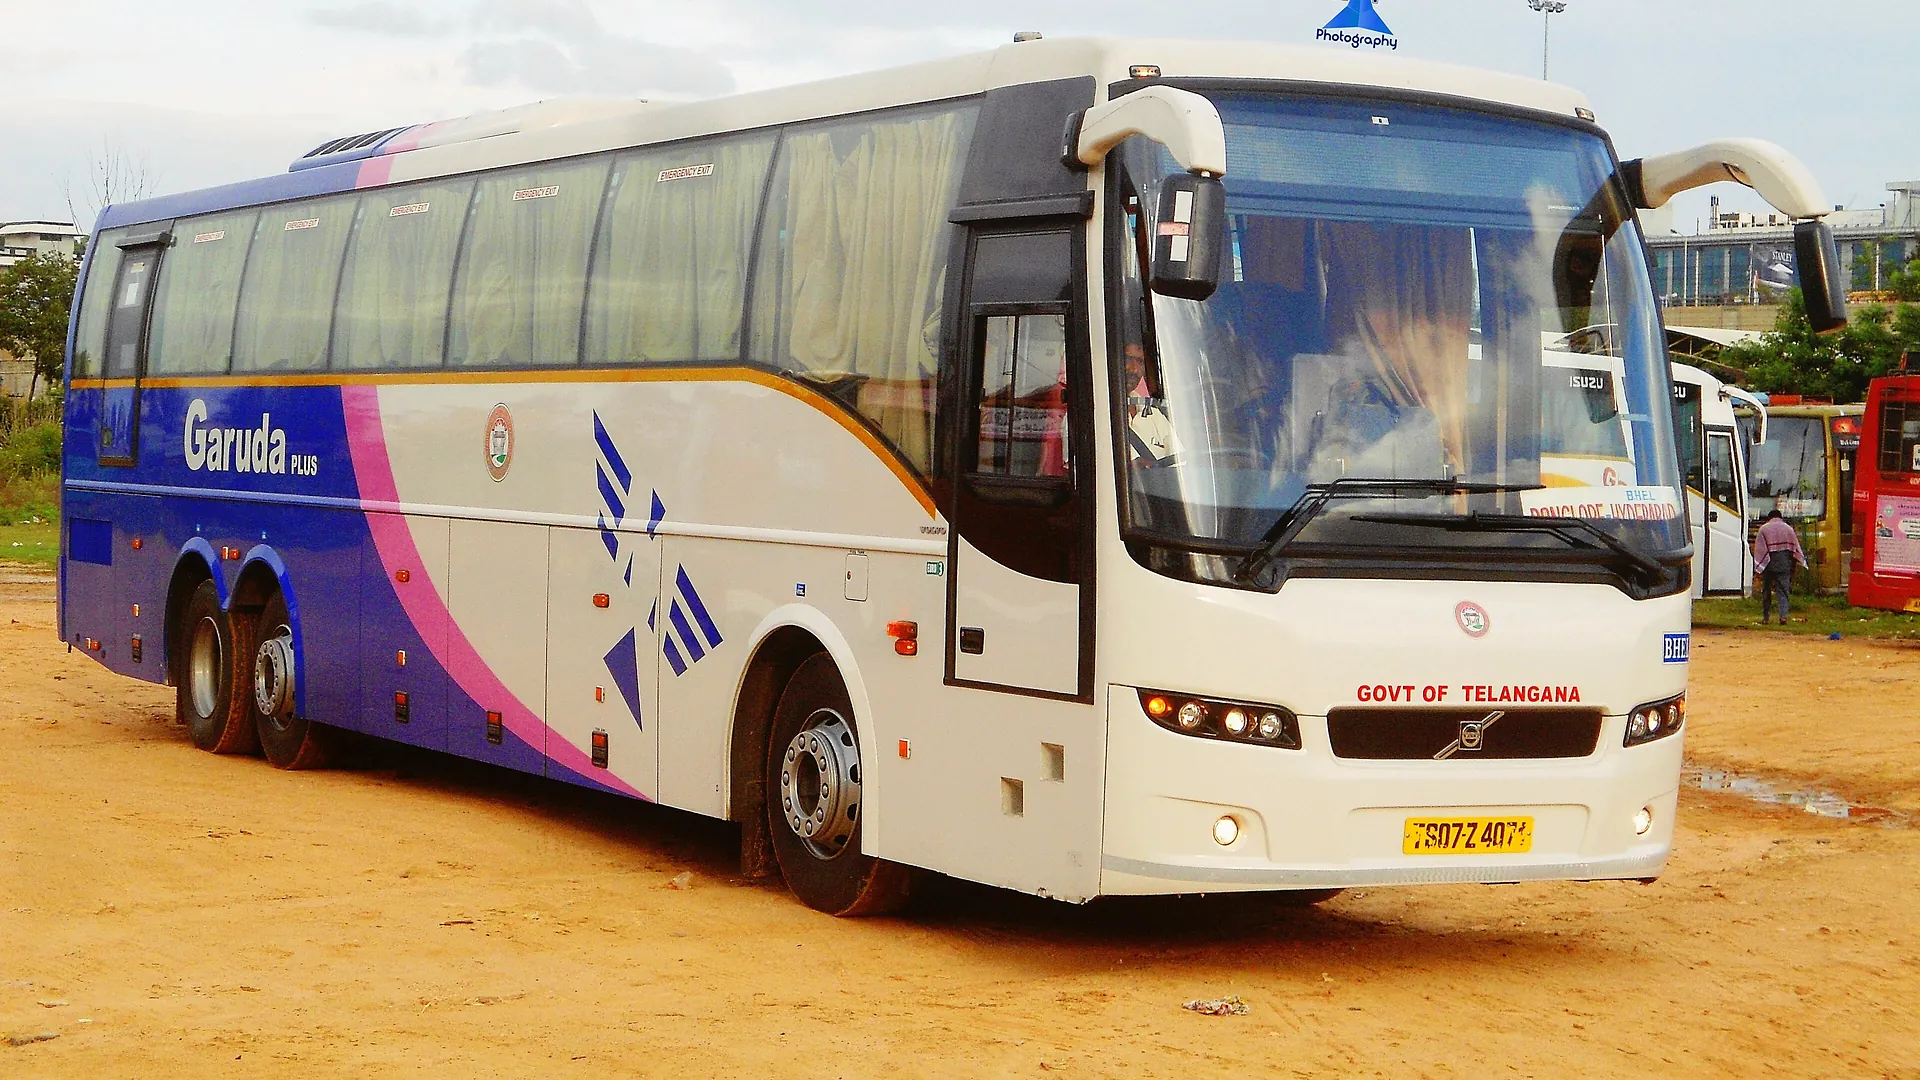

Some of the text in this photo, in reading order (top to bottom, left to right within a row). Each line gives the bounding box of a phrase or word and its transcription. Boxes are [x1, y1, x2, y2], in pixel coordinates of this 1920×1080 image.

[660, 165, 712, 180] EMERGENCY EXIT
[1569, 375, 1604, 390] ISUZU
[184, 398, 318, 476] Garuda PLUS
[1626, 489, 1656, 501] BHEL
[1357, 684, 1581, 703] GOVT OF TELANGANA
